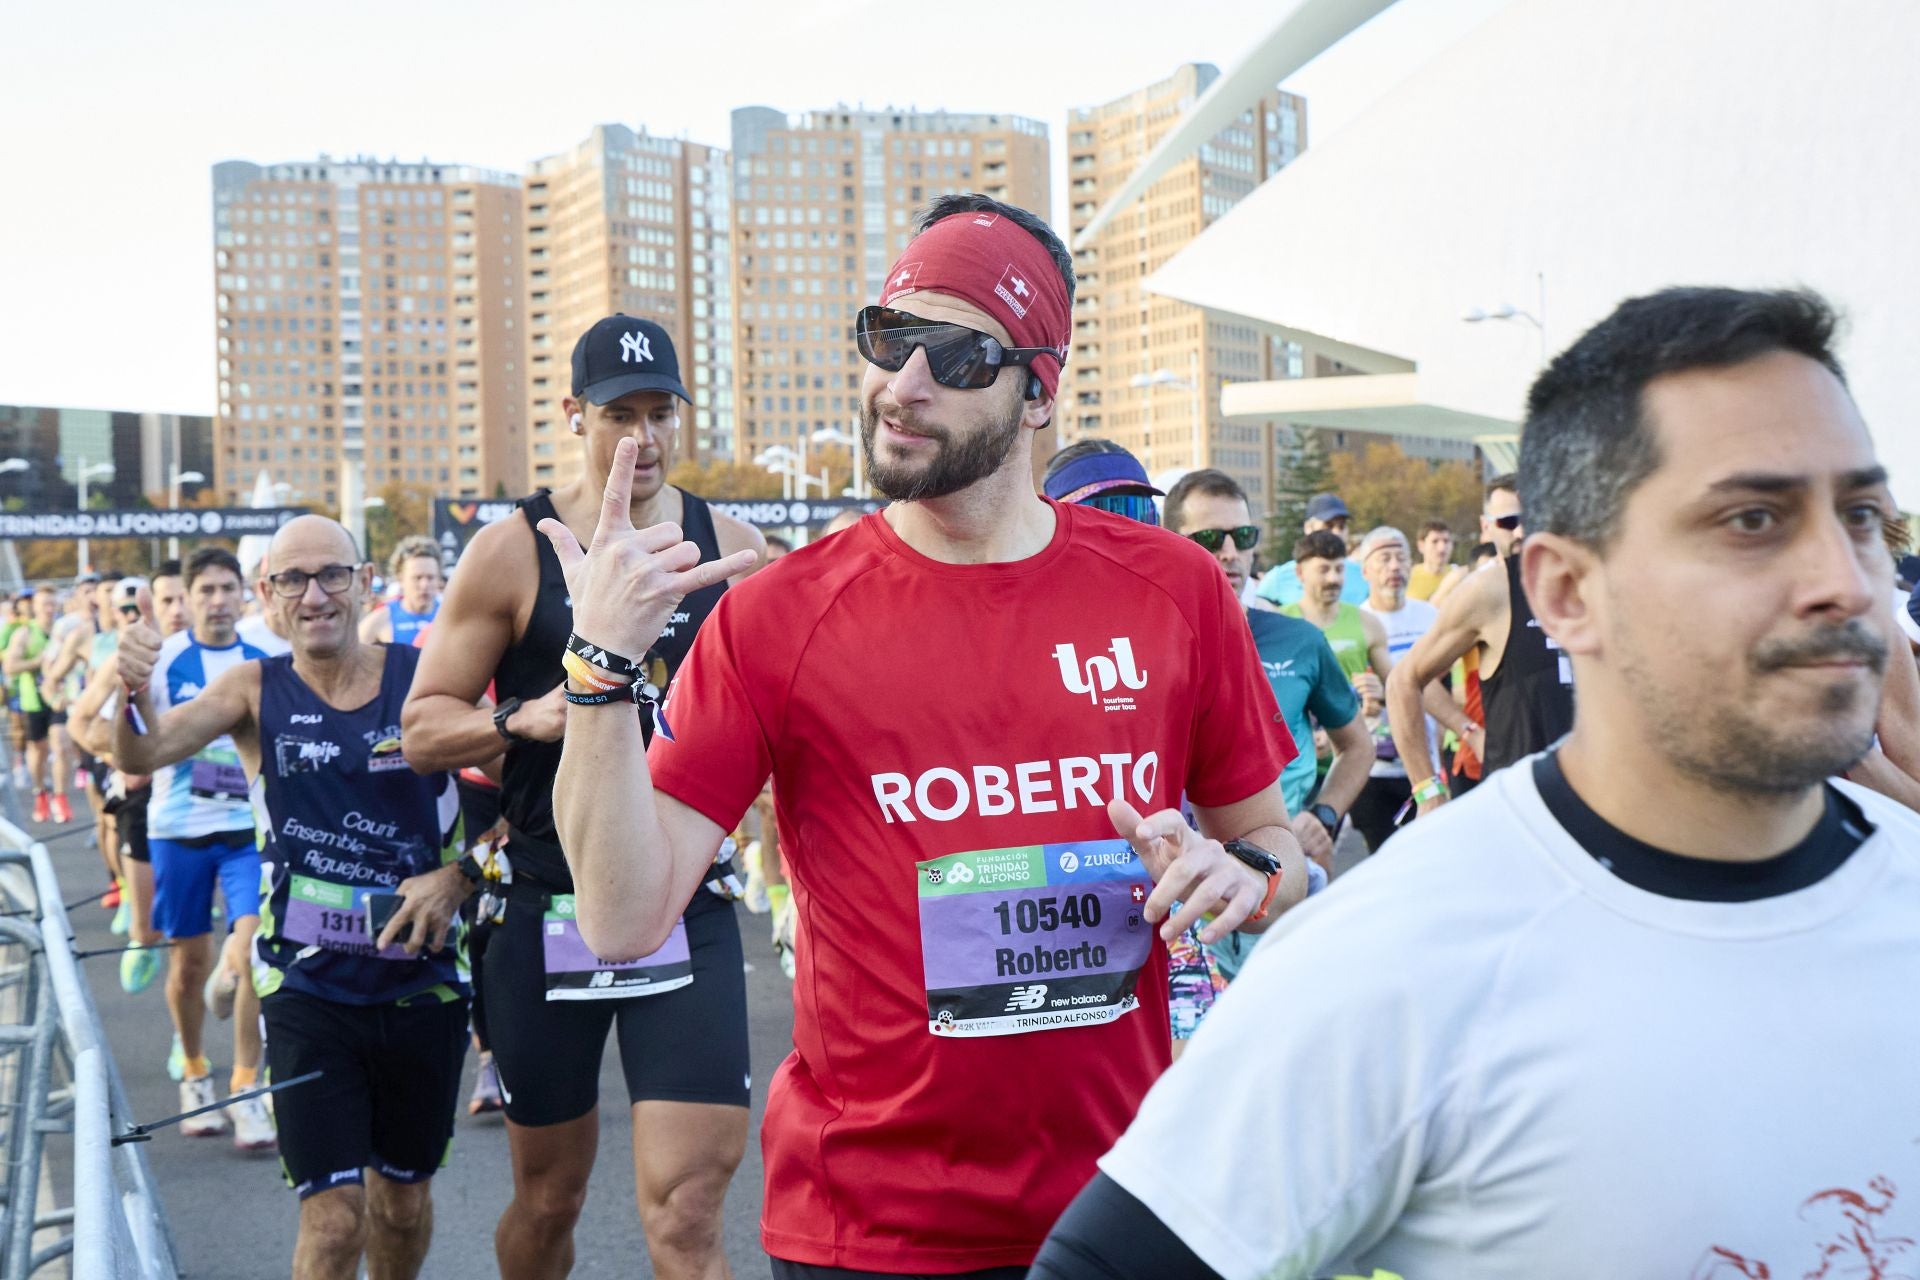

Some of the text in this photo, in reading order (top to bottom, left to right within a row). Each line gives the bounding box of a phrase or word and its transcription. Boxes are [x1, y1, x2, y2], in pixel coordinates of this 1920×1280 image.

[619, 331, 654, 362] NY
[714, 503, 788, 523] FONSO
[0, 513, 95, 536] TRINIDAD
[96, 512, 199, 535] ALFONSO
[1122, 703, 1136, 711] tous
[871, 751, 1158, 823] ROBERTO
[342, 811, 400, 838] Courir
[282, 817, 367, 855] Ensemble
[976, 853, 1028, 863] FUNDACIÓN
[976, 861, 1029, 874] TRINIDAD
[1084, 852, 1131, 867] ZURICH
[978, 871, 1030, 884] ALFONSO
[320, 911, 366, 934] 1311
[993, 893, 1101, 935] 10540
[1128, 915, 1139, 927] 06
[995, 941, 1107, 977] Roberto
[1050, 997, 1071, 1008] new
[1071, 993, 1108, 1005] balance
[1016, 1015, 1061, 1028] TRINIDAD
[1063, 1010, 1107, 1024] ALFONSO
